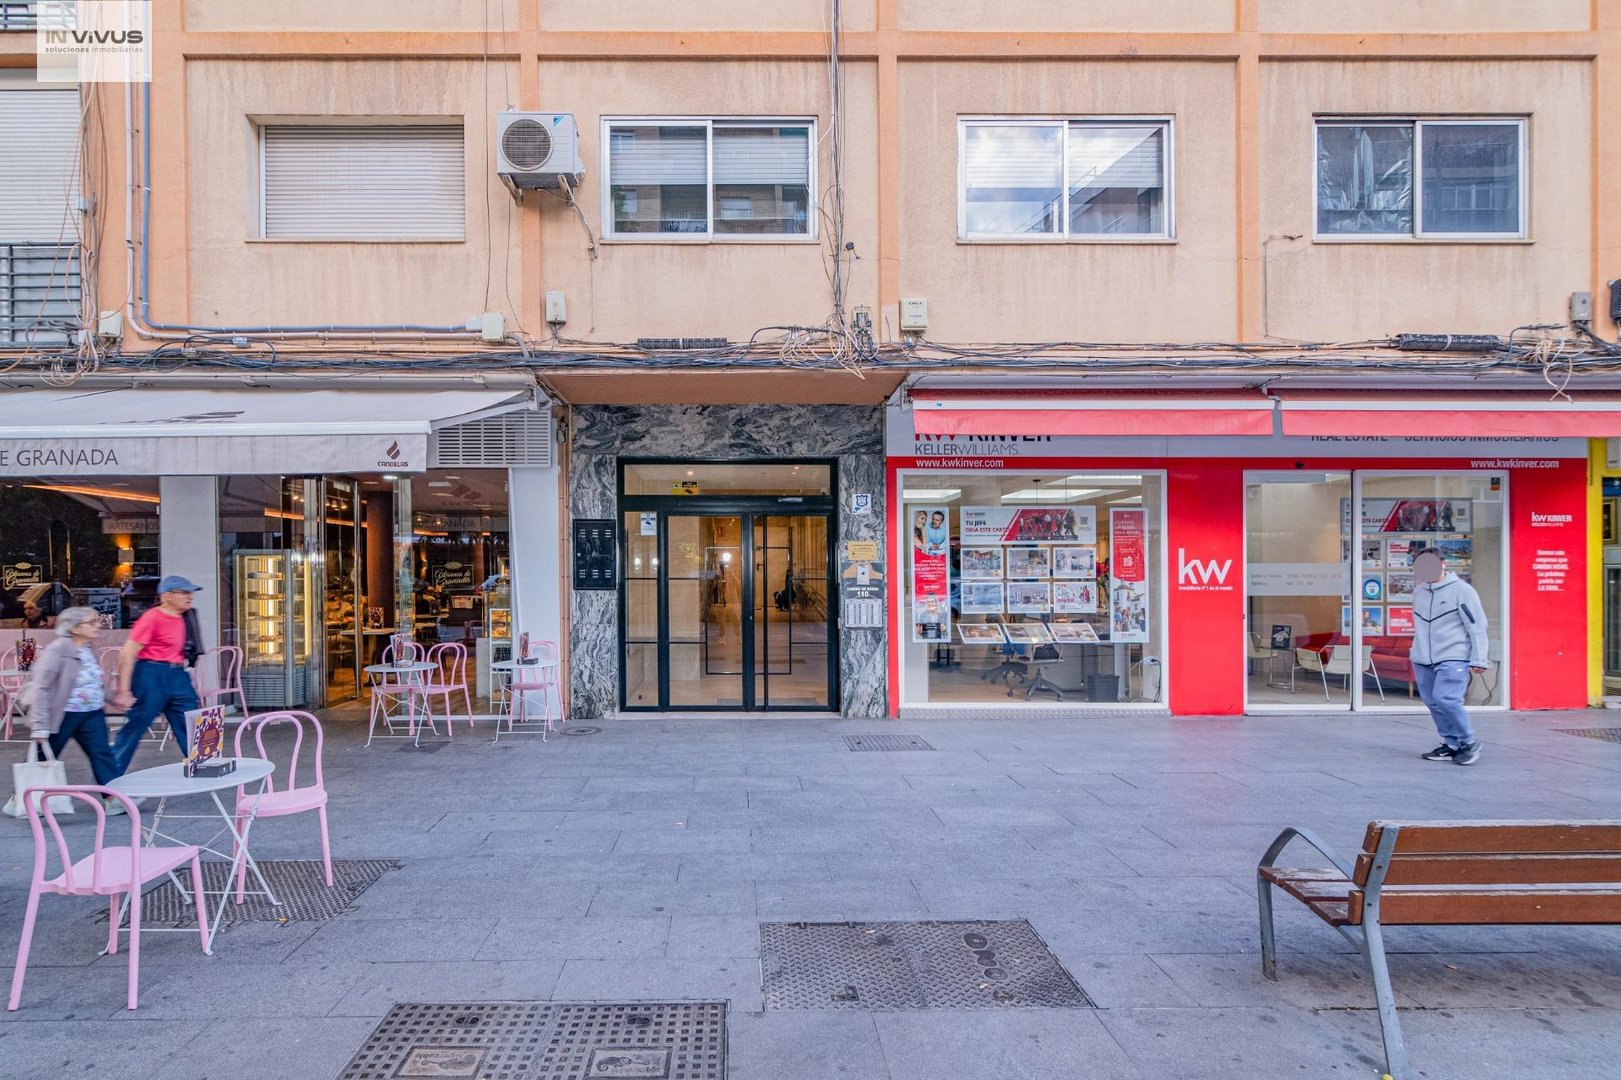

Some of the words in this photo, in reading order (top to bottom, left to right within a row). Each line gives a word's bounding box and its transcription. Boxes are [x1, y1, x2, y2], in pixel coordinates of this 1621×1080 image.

[16, 448, 119, 467] GRANADA
[915, 457, 1004, 469] www.kwkinver.com
[1470, 458, 1559, 469] www.kwkinver.com
[1178, 547, 1233, 585] kw
